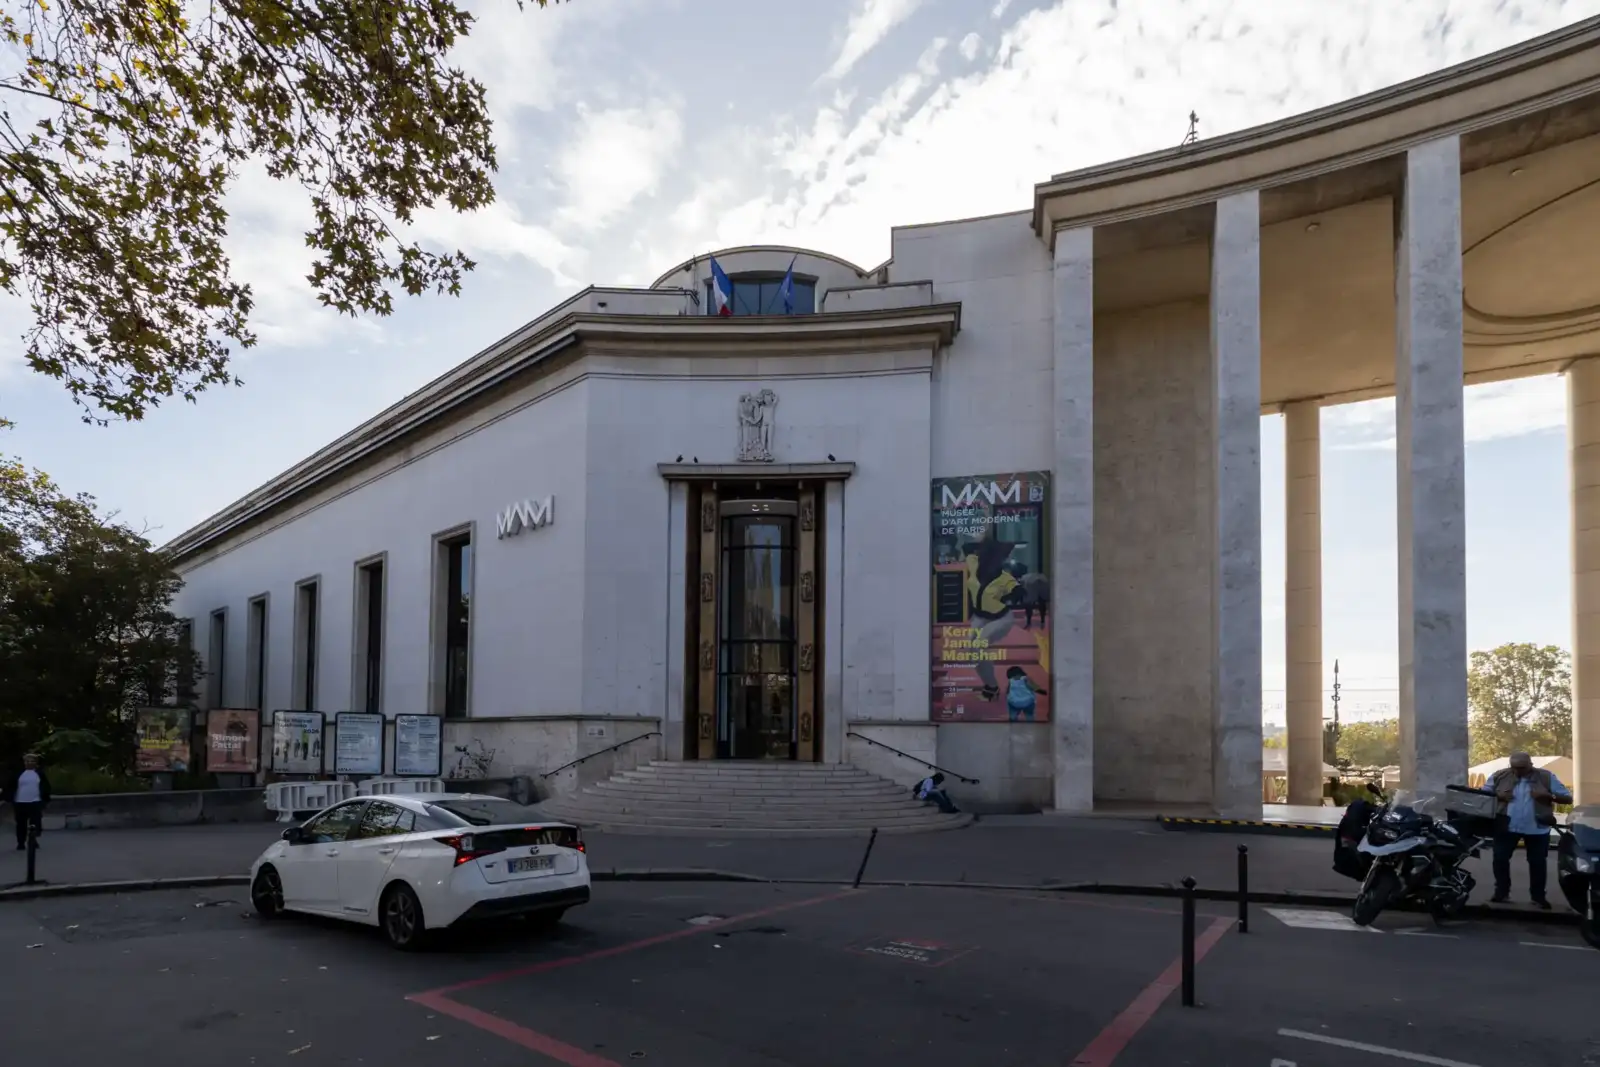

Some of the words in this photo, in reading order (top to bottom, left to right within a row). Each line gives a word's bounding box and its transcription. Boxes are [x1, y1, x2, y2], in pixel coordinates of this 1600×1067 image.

[942, 507, 975, 518] MUSÉE
[942, 517, 968, 526] D'ART
[971, 514, 1021, 524] MODERNE
[942, 527, 955, 535] DE
[957, 525, 986, 534] PARIS
[943, 626, 984, 640] Kerry
[943, 638, 989, 649] James
[943, 648, 1008, 661] Marshall
[211, 733, 251, 742] Simone
[211, 741, 242, 749] Fattal
